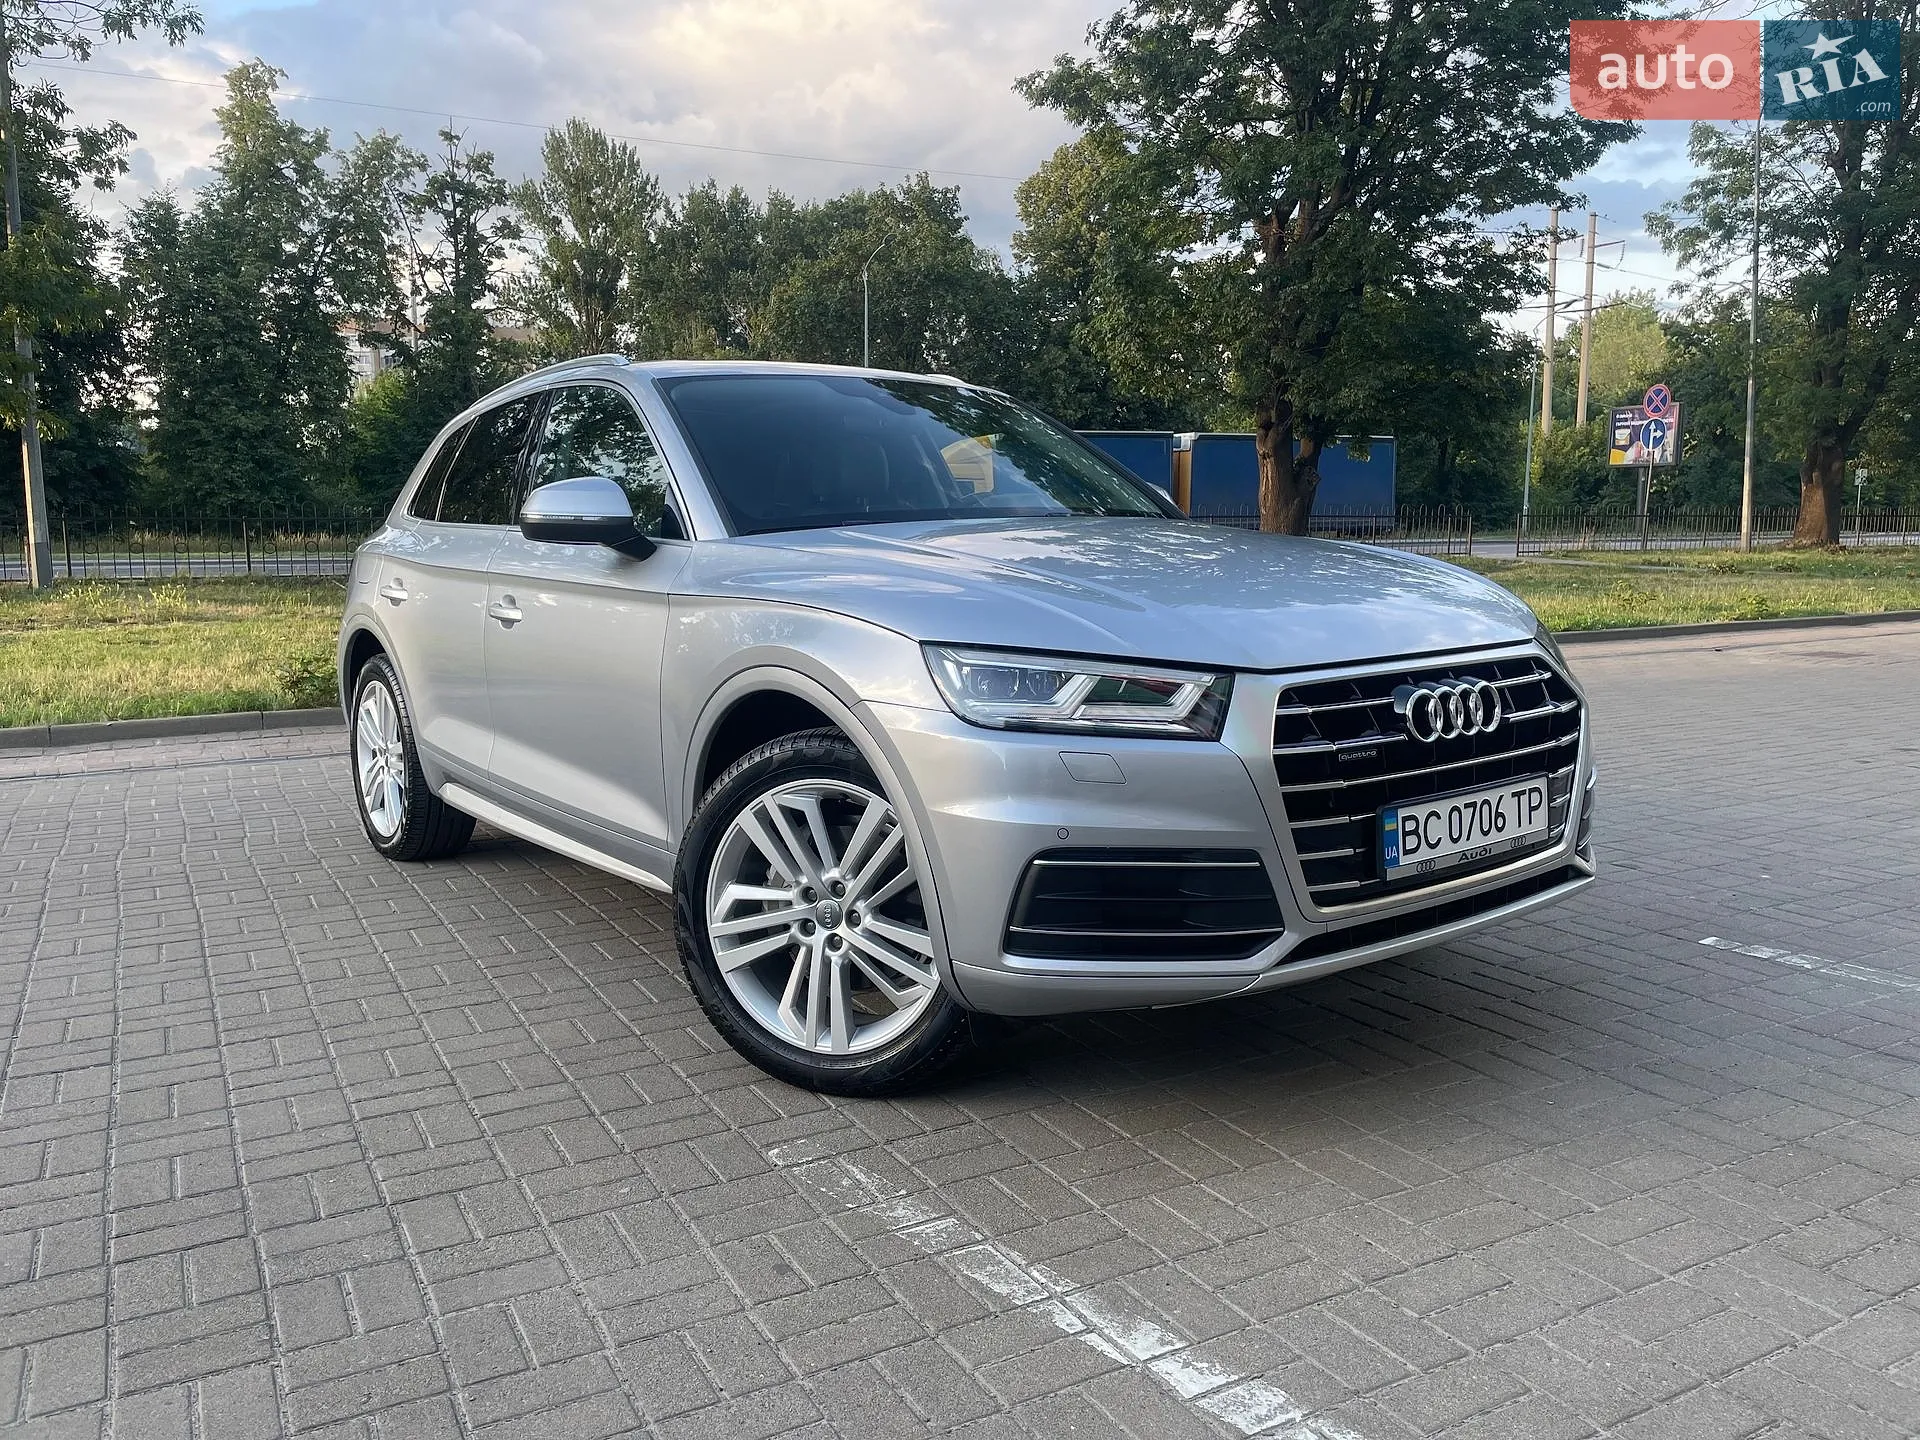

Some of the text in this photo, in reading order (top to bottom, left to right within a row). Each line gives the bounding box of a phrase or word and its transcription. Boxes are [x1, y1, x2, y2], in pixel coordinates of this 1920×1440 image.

[1340, 750, 1377, 761] quattro
[1401, 785, 1543, 856] BC 0706 TP
[1385, 846, 1398, 860] UA
[1457, 847, 1493, 863] Audi
